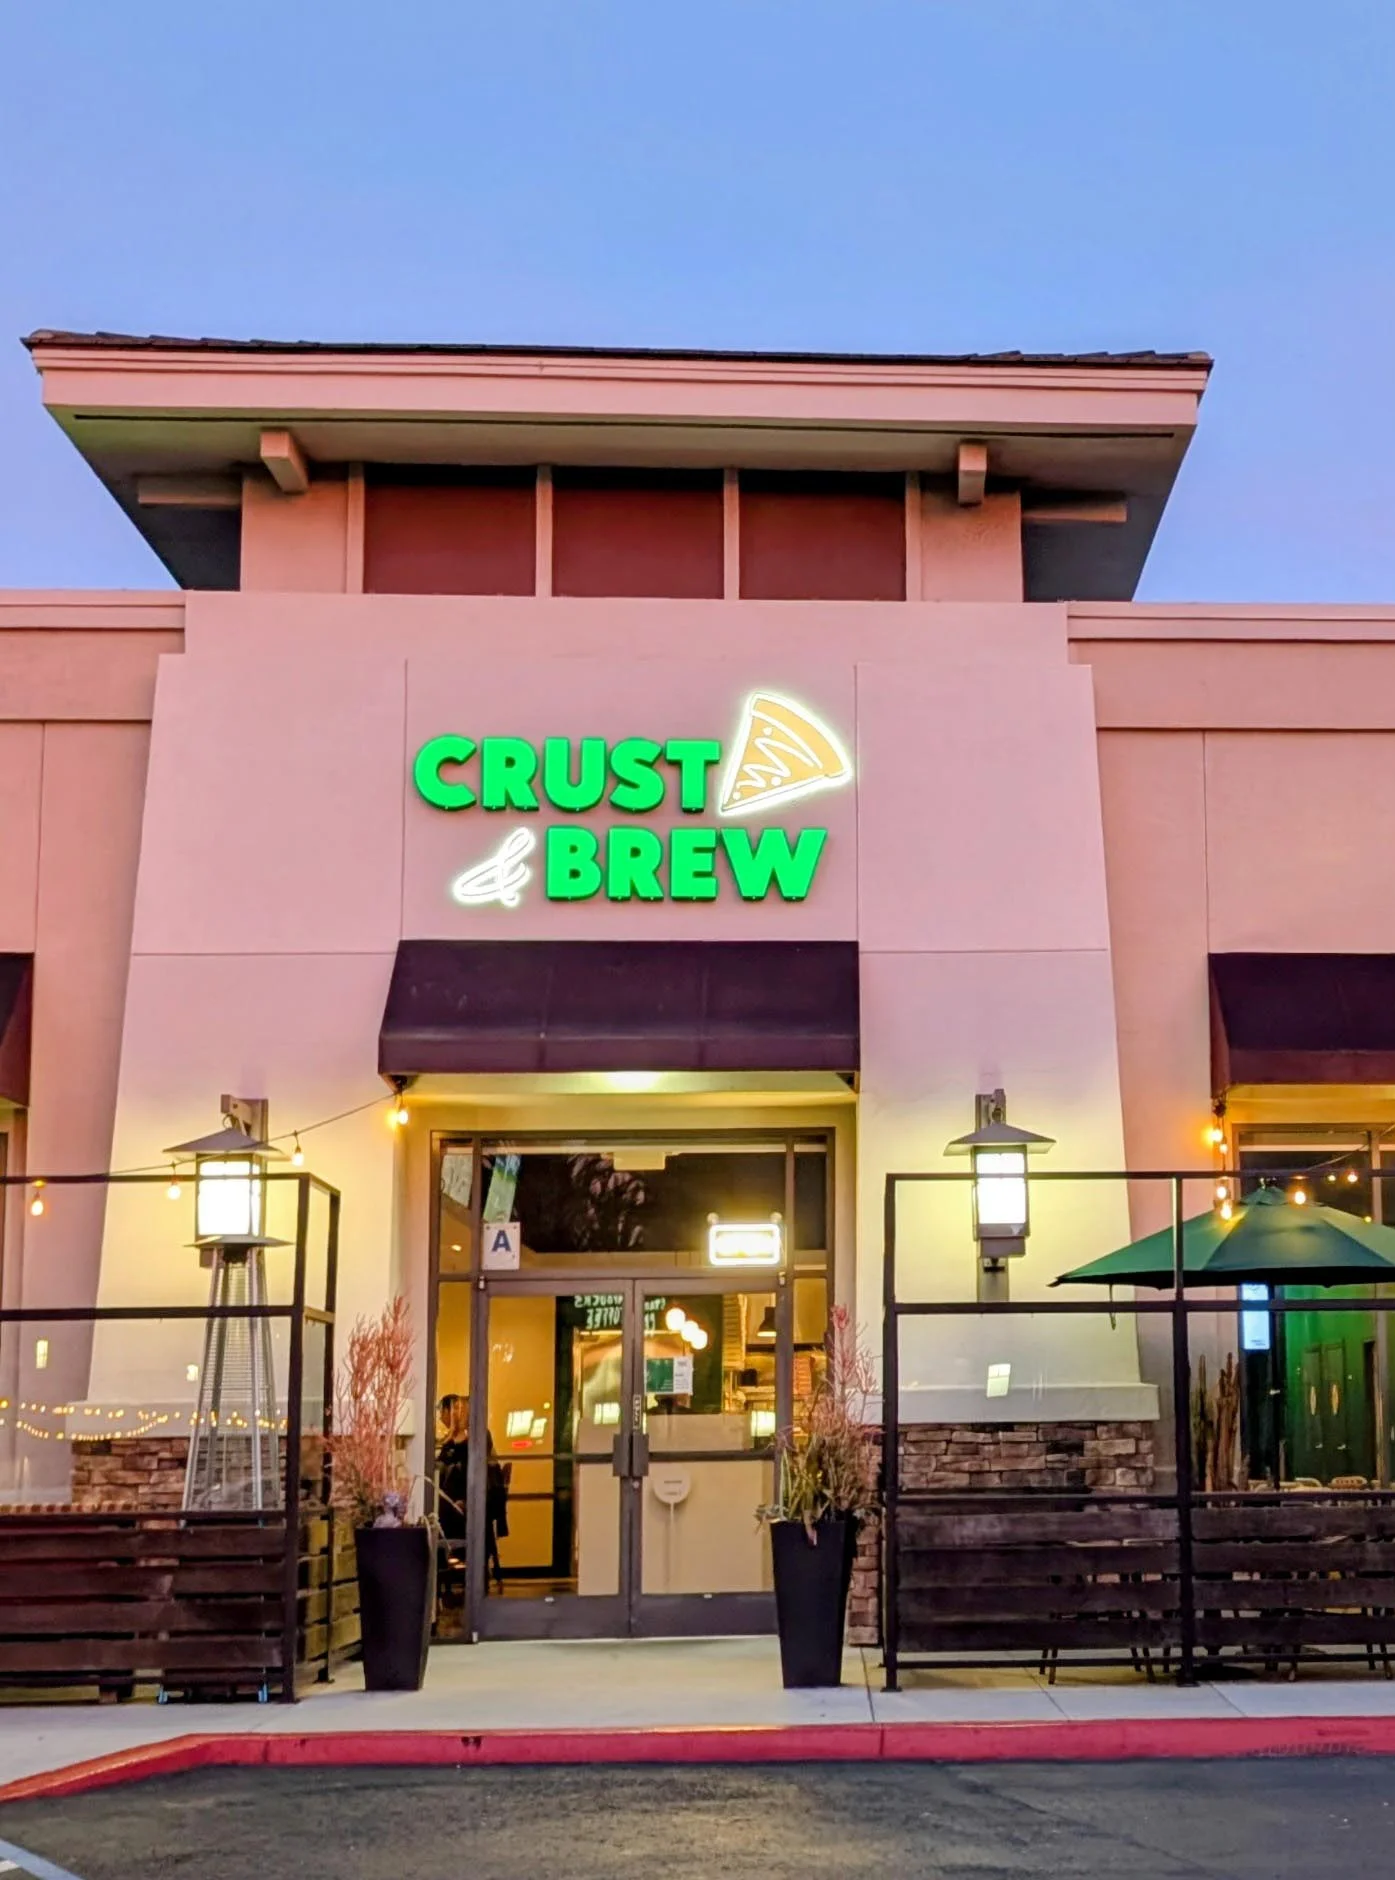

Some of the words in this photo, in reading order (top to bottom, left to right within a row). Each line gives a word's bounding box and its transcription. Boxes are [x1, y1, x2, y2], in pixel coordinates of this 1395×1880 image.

[413, 733, 720, 813] CRUST
[454, 826, 534, 907] &
[546, 825, 828, 903] BREW
[491, 1229, 512, 1252] A
